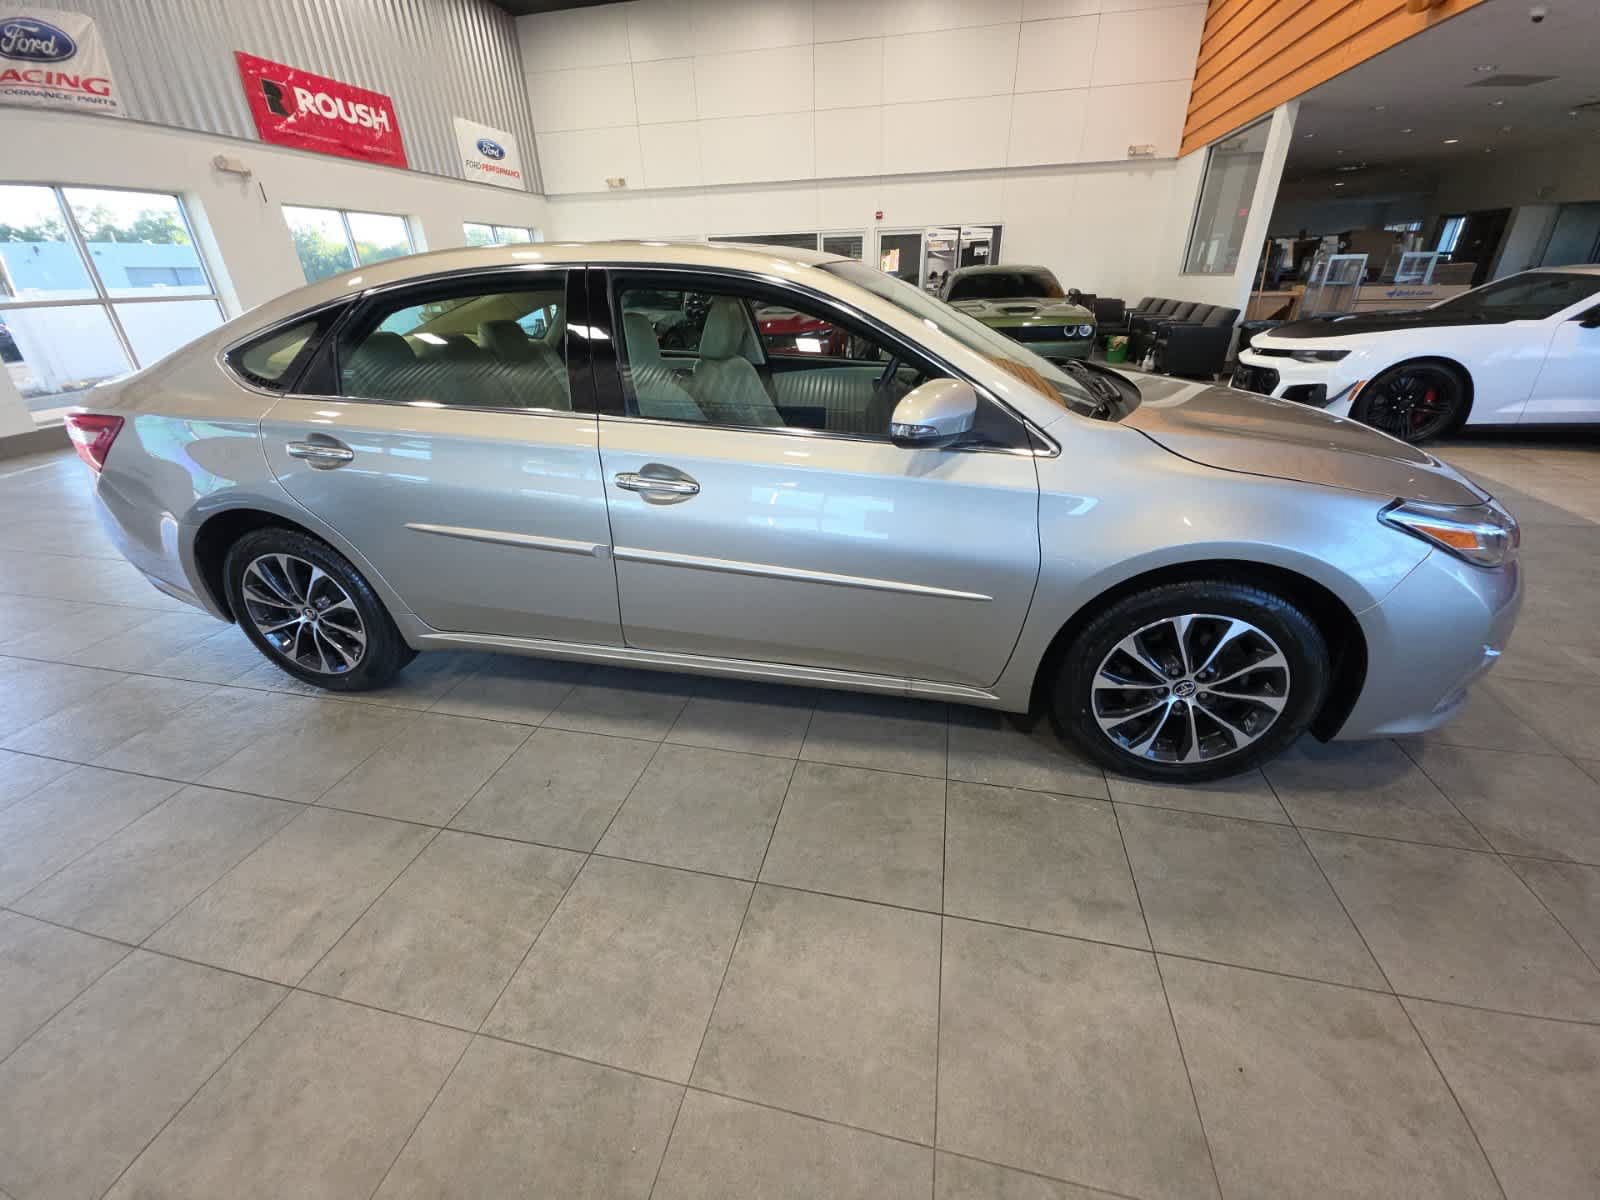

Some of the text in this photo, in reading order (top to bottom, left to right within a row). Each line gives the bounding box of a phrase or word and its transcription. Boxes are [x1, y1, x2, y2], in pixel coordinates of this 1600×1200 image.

[1, 24, 58, 55] Ford
[0, 69, 109, 96] ACING
[78, 95, 117, 107] PARTS
[293, 86, 391, 132] ROUSH
[482, 143, 500, 157] Ford
[465, 159, 481, 169] FORD
